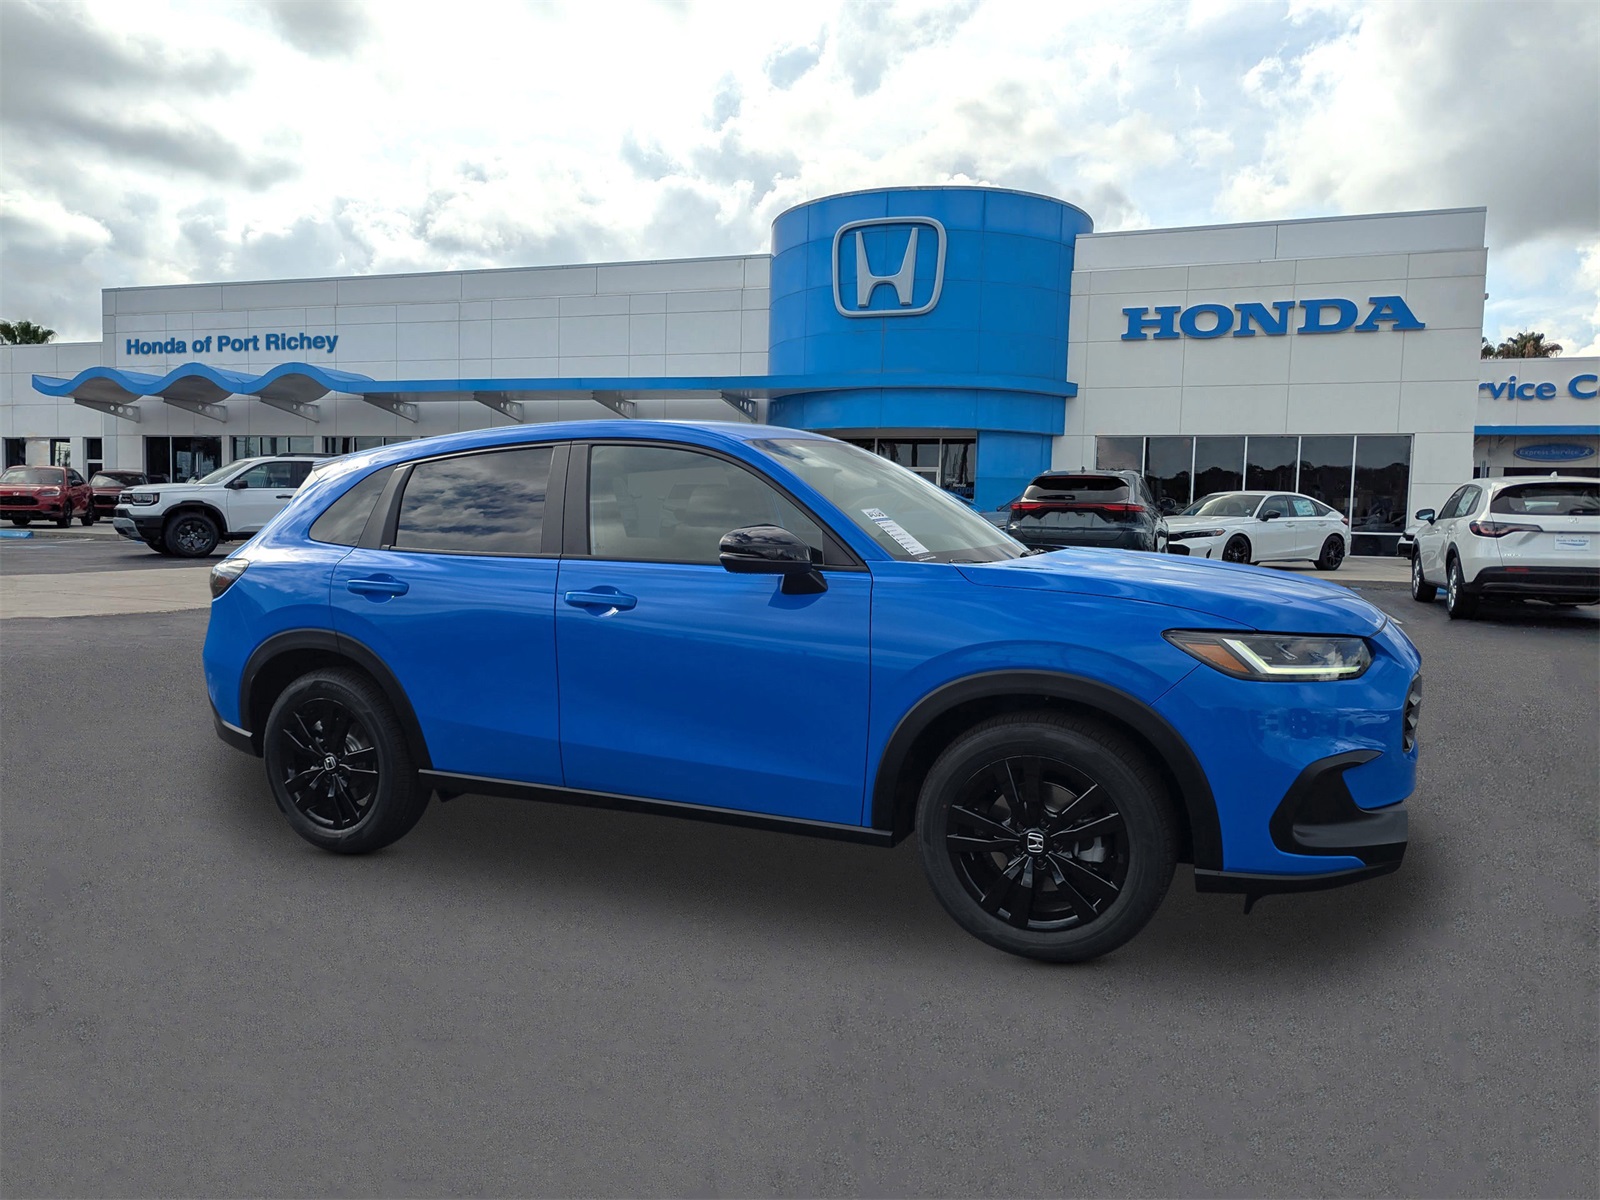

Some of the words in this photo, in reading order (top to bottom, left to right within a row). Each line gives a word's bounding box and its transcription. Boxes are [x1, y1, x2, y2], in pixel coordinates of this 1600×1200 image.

[1120, 295, 1426, 340] HONDA
[126, 337, 187, 355] Honda
[191, 335, 213, 353] of
[217, 335, 260, 353] Port
[265, 332, 339, 354] Richey
